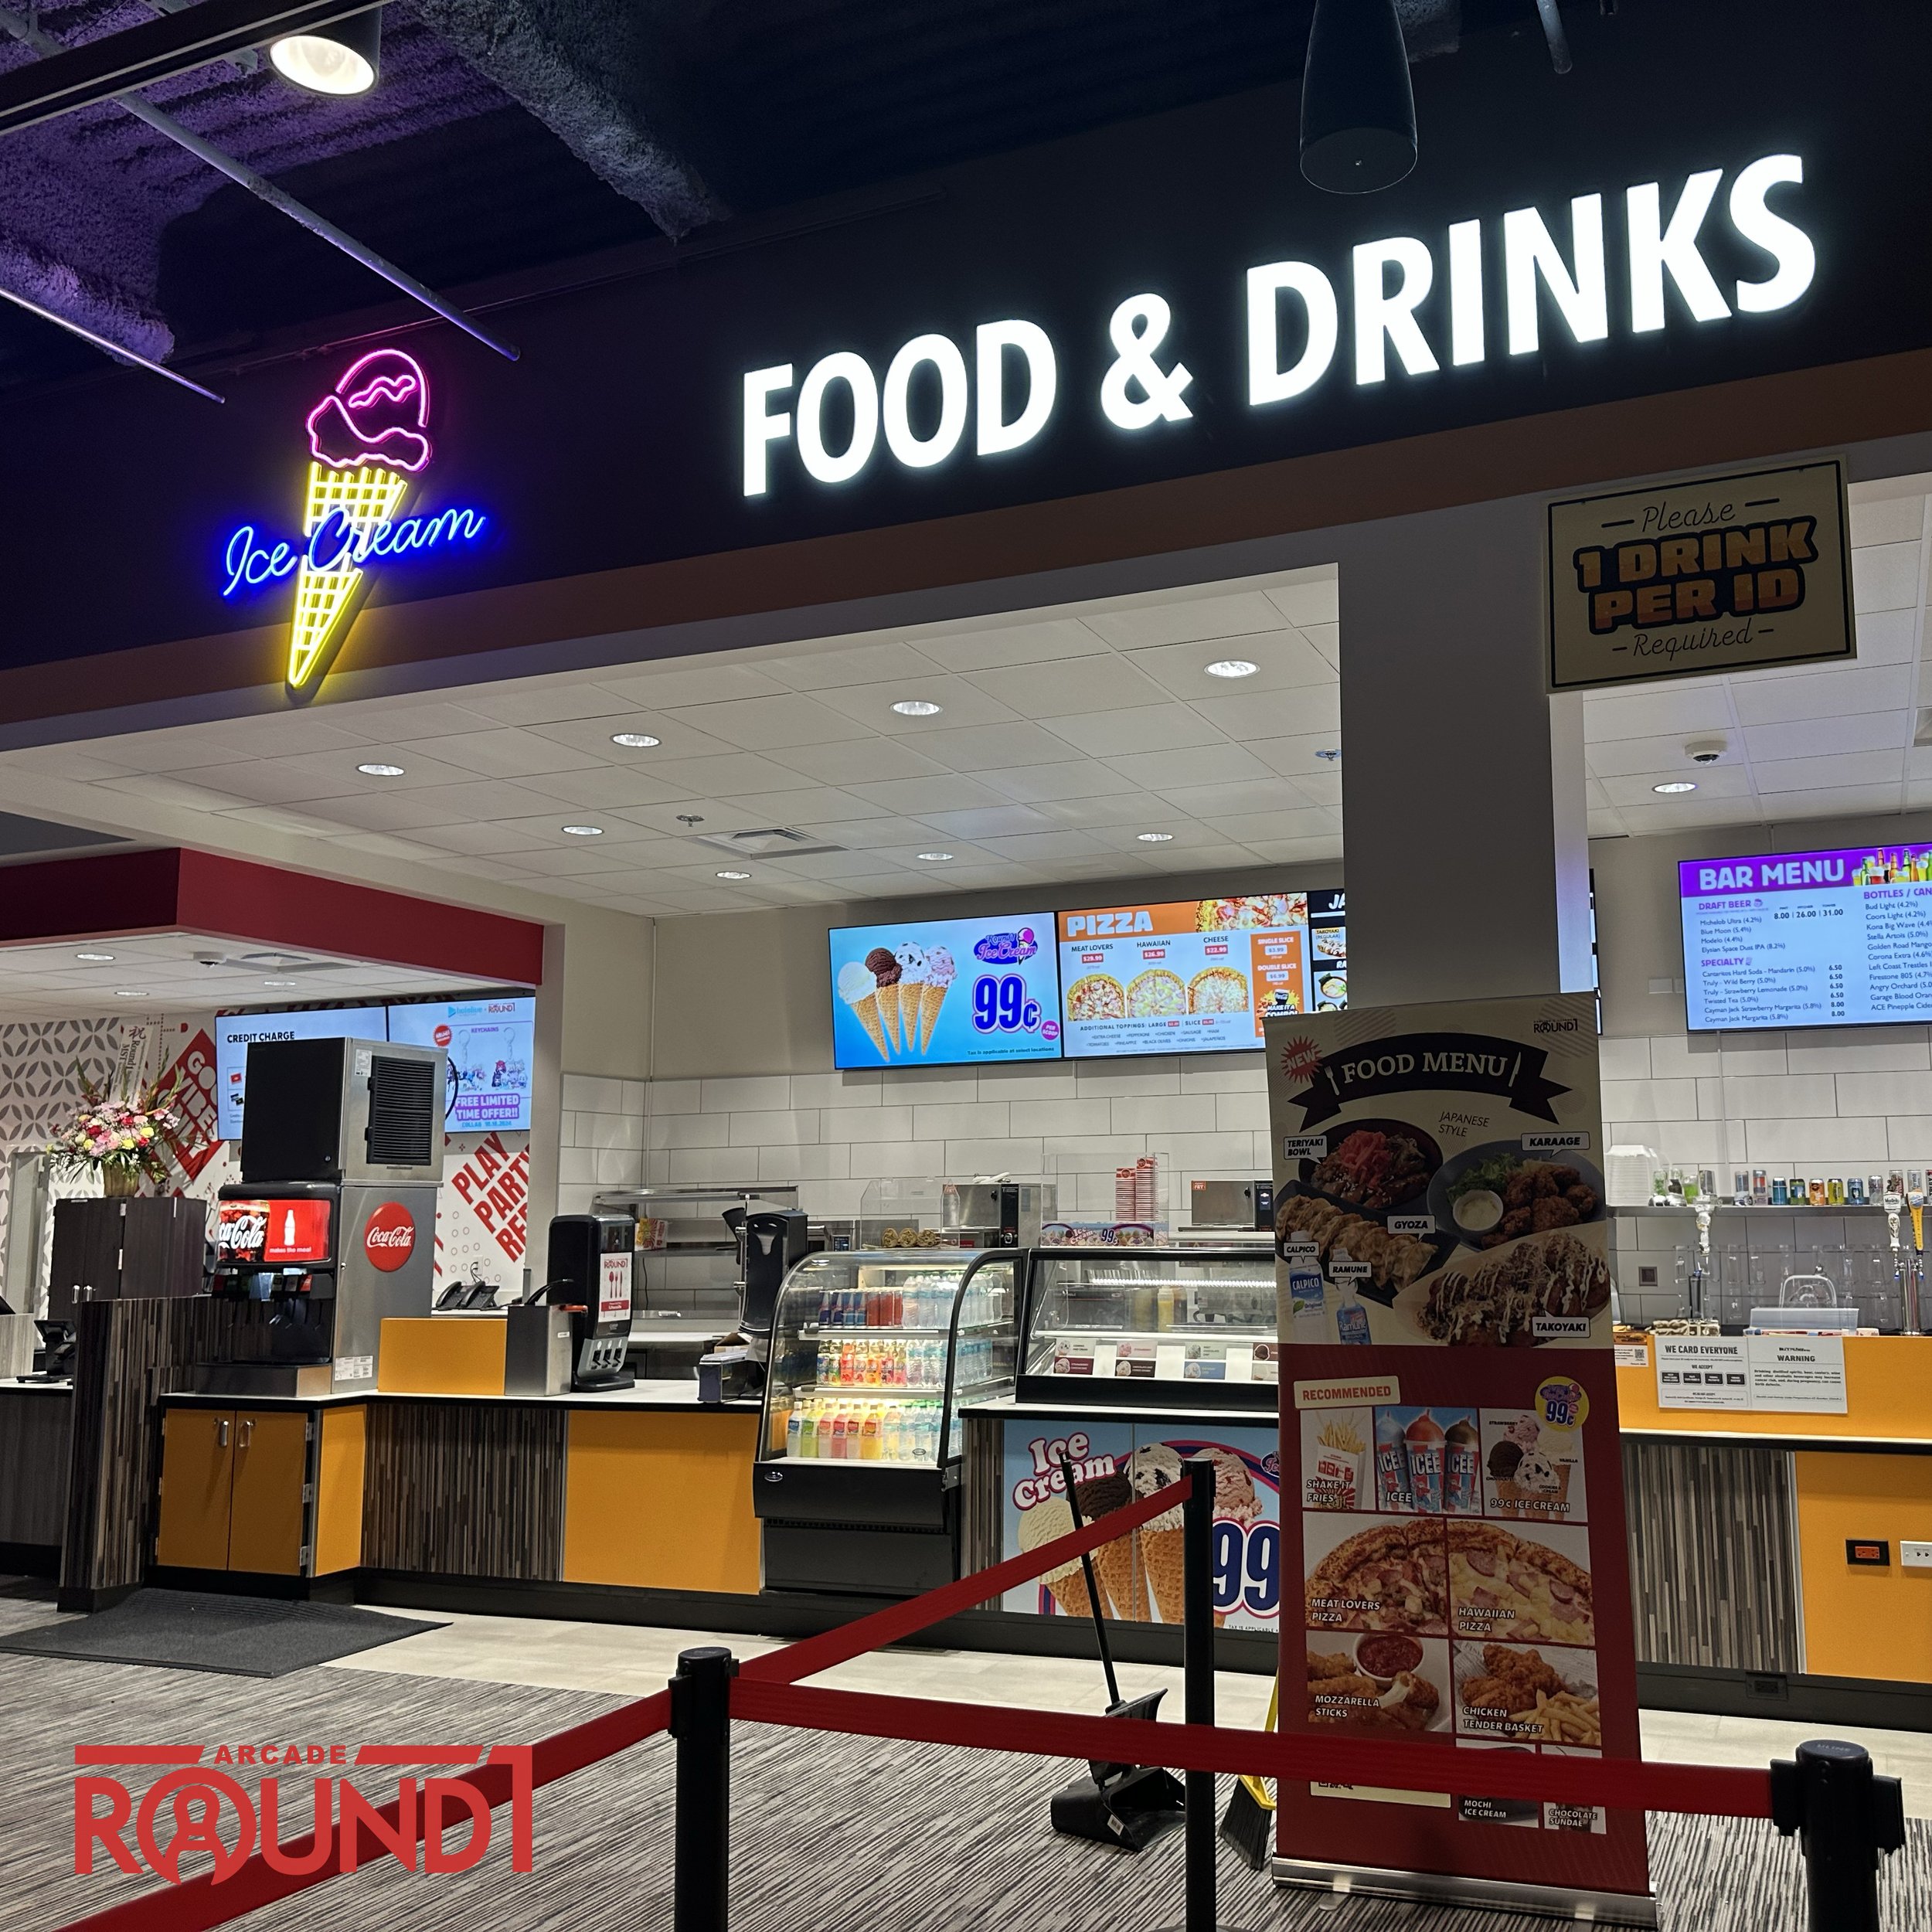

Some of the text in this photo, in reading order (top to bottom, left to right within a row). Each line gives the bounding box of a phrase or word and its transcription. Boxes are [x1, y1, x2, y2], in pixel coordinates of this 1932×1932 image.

[743, 155, 1816, 497] FOOD & DRINKS
[1642, 502, 1736, 532] Please
[223, 506, 486, 595] Ice Cream
[1577, 521, 1813, 590] 1 DRINK
[1594, 568, 1800, 631] PER ID
[1633, 618, 1753, 661] Required
[1700, 859, 1844, 890] BAR MENU
[1864, 889, 1903, 899] BOTTLES
[1699, 902, 1726, 910] DRAFT
[1066, 910, 1153, 937] PIZZA
[977, 942, 1036, 960] Ice Cream
[1701, 958, 1743, 967] SPECIALTY
[974, 975, 1040, 1032] 99¢
[227, 1031, 294, 1043] CREDIT CHARGE
[1287, 1049, 1316, 1071] NEW
[1341, 1052, 1508, 1083] FOOD MENU
[456, 1094, 519, 1107] FREE LIMITED
[457, 1107, 519, 1119] TIME OFFER!!
[1438, 1111, 1490, 1128] JAPANESE
[1438, 1124, 1468, 1138] STYLE
[1287, 1138, 1324, 1148] TERIYAKI
[1529, 1136, 1580, 1148] KARAAGE
[1287, 1148, 1311, 1156] BOWL
[451, 1131, 510, 1206] PLAY
[1393, 1219, 1429, 1230] GYOZA
[1070, 1230, 1097, 1245] Cream
[1073, 1226, 1087, 1237] Ice
[1292, 1278, 1319, 1290] CALPICO
[1535, 1321, 1587, 1332] TAKOYAKI
[1679, 1345, 1699, 1354] CARD
[1700, 1346, 1738, 1355] EVERYONE
[1303, 1386, 1391, 1401] RECOMMENDED
[1028, 1432, 1090, 1476] Ice
[1377, 1451, 1406, 1473] ICEE
[1410, 1452, 1441, 1475] ICEE
[1447, 1454, 1475, 1475] ICEE
[1306, 1479, 1351, 1489] SHAKE IT
[1307, 1493, 1334, 1502] FRIES
[1386, 1492, 1412, 1502] ICEE
[1515, 1499, 1530, 1509] ICE
[1533, 1501, 1570, 1512] CREAM
[1311, 1599, 1380, 1611] MEAT LOVERS
[1311, 1612, 1343, 1622] PIZZA
[1458, 1607, 1515, 1618] HAWAIIAN
[1459, 1621, 1492, 1632] PIZZA
[1315, 1696, 1380, 1707] MOZZARELLA
[1315, 1708, 1348, 1717] STICKS
[1463, 1706, 1507, 1717] CHICKEN
[1464, 1719, 1543, 1733] TENDER BASKET
[1464, 1800, 1492, 1808] MOCHI
[1478, 1809, 1506, 1818] CREAM
[1549, 1808, 1597, 1820] CHOCOLATE
[1549, 1818, 1583, 1827] SUNDAE
